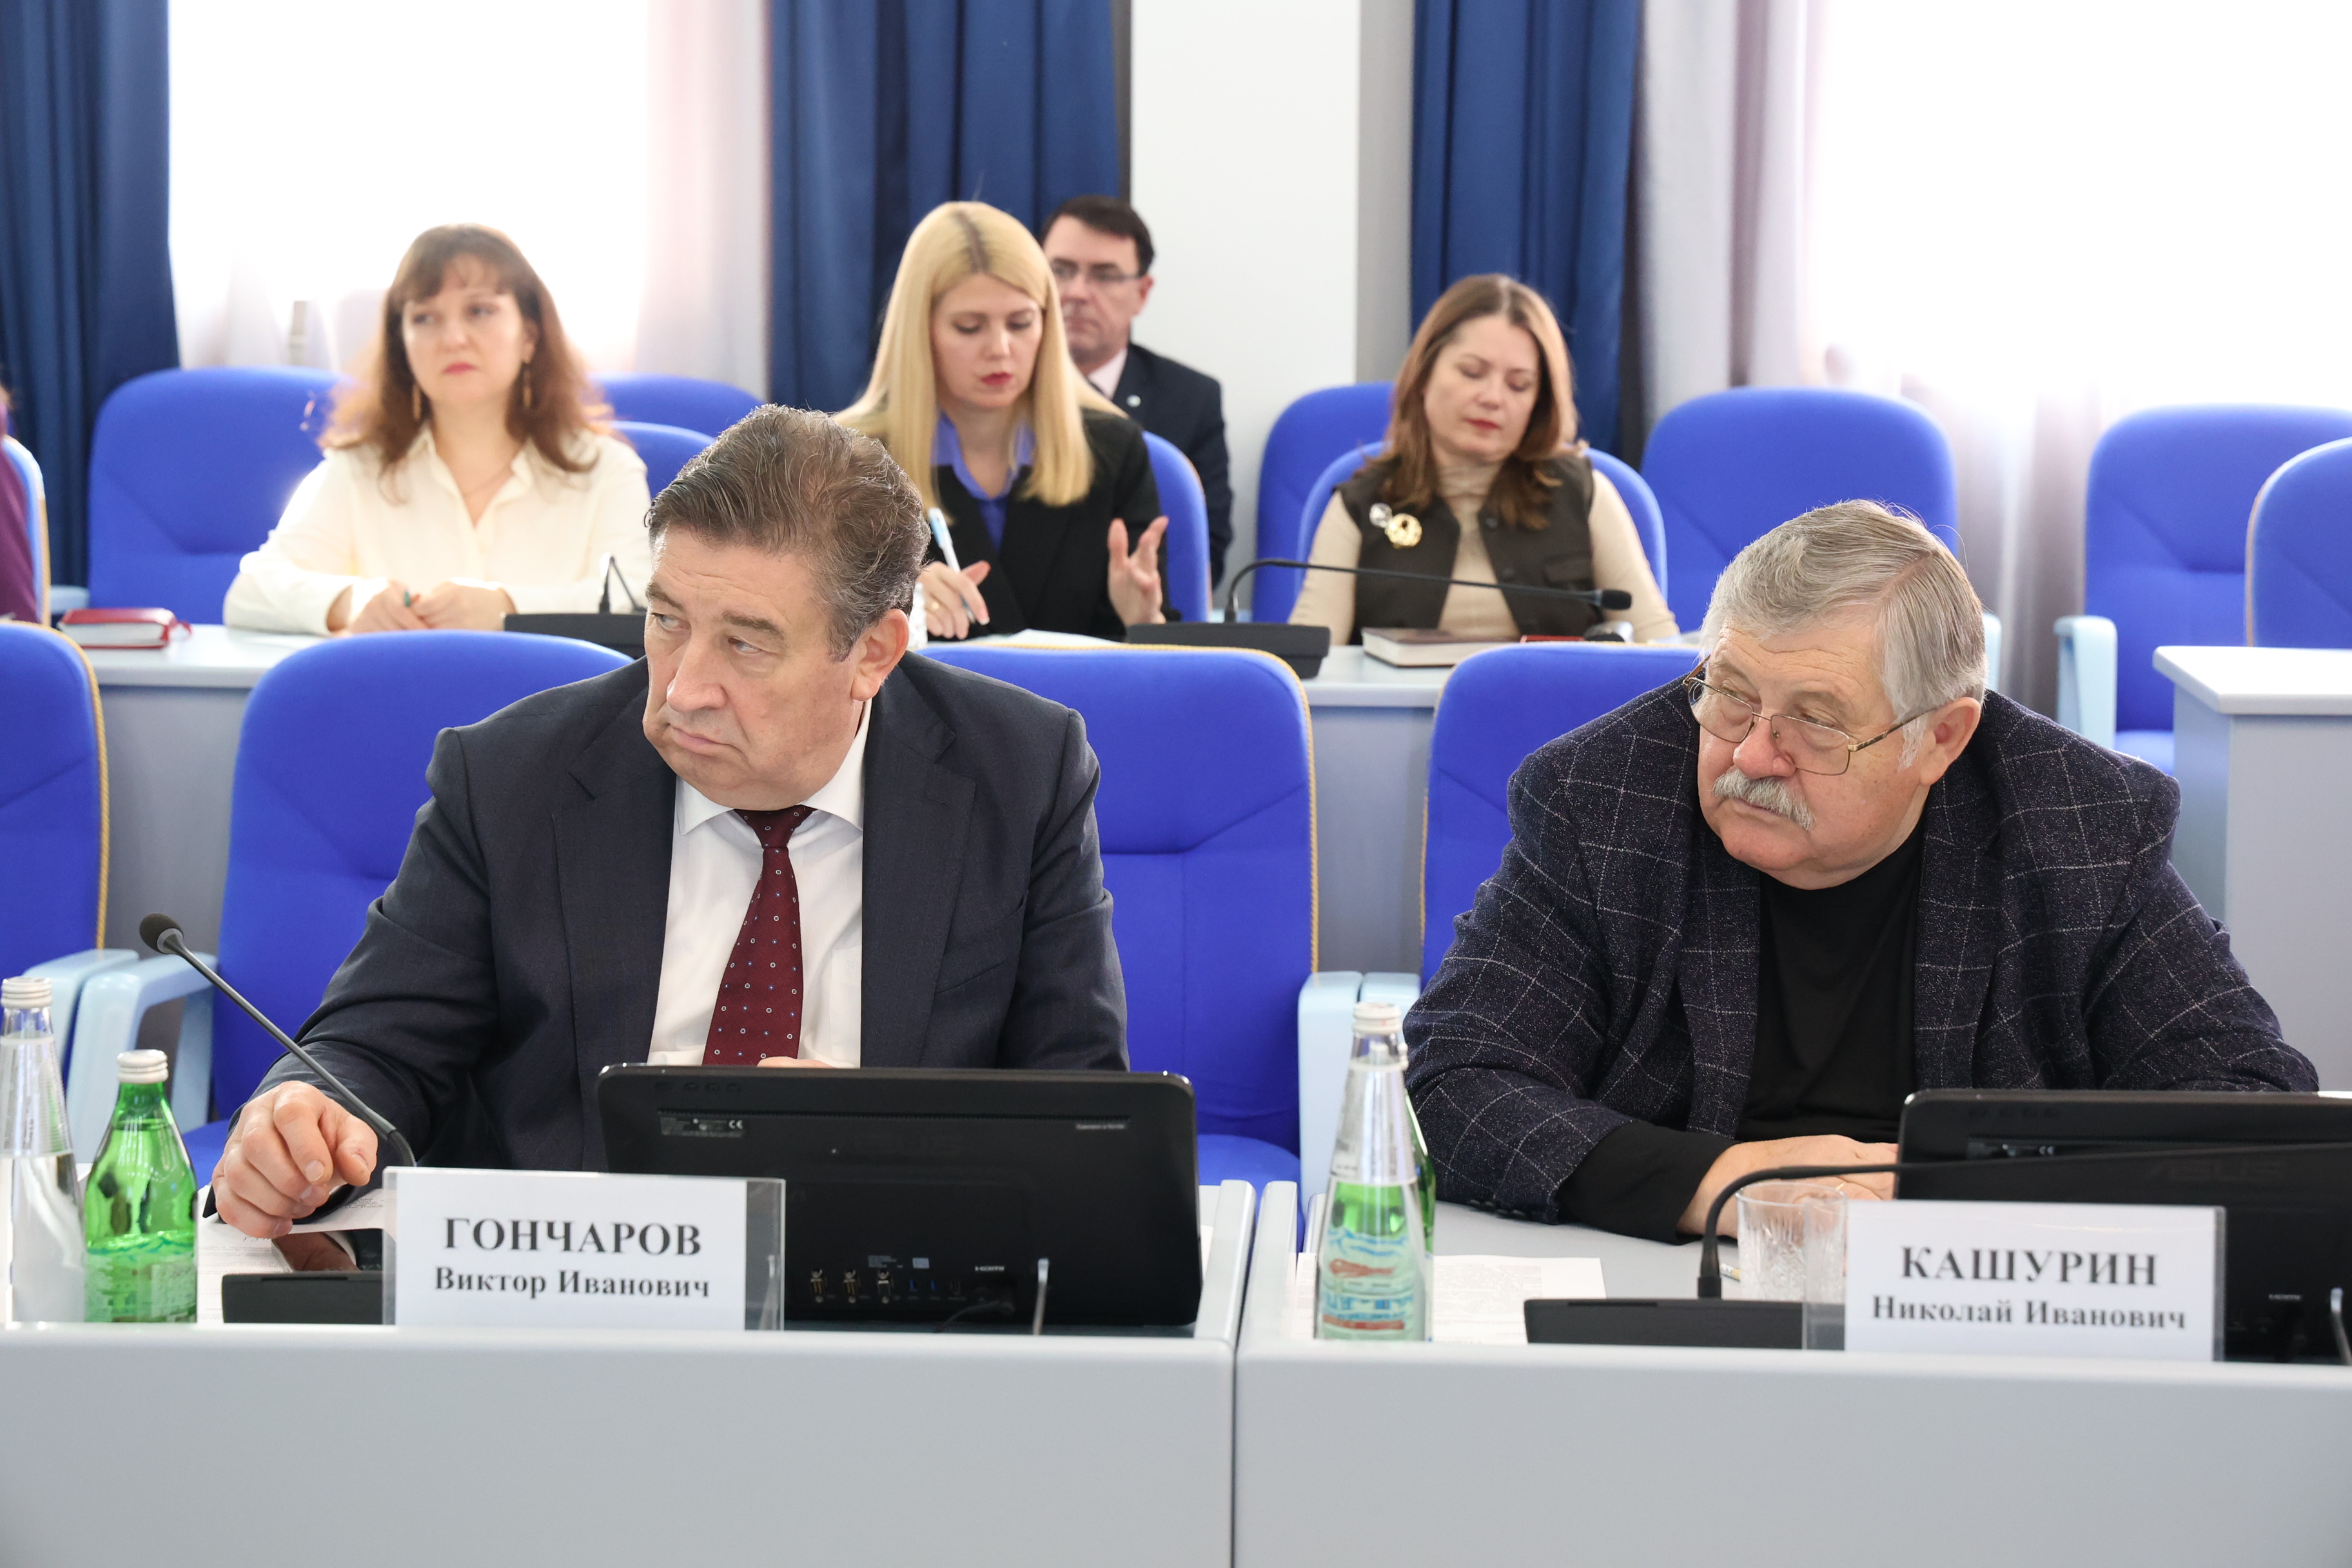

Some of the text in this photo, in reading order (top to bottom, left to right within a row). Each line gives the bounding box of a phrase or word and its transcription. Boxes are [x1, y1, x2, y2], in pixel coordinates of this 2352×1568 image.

[444, 1217, 702, 1257] ГОНЧАРОВ
[435, 1266, 710, 1300] Виктор Иванович
[1901, 1247, 2159, 1286] КАШУРИН
[1872, 1295, 2186, 1329] Николай Иванович
